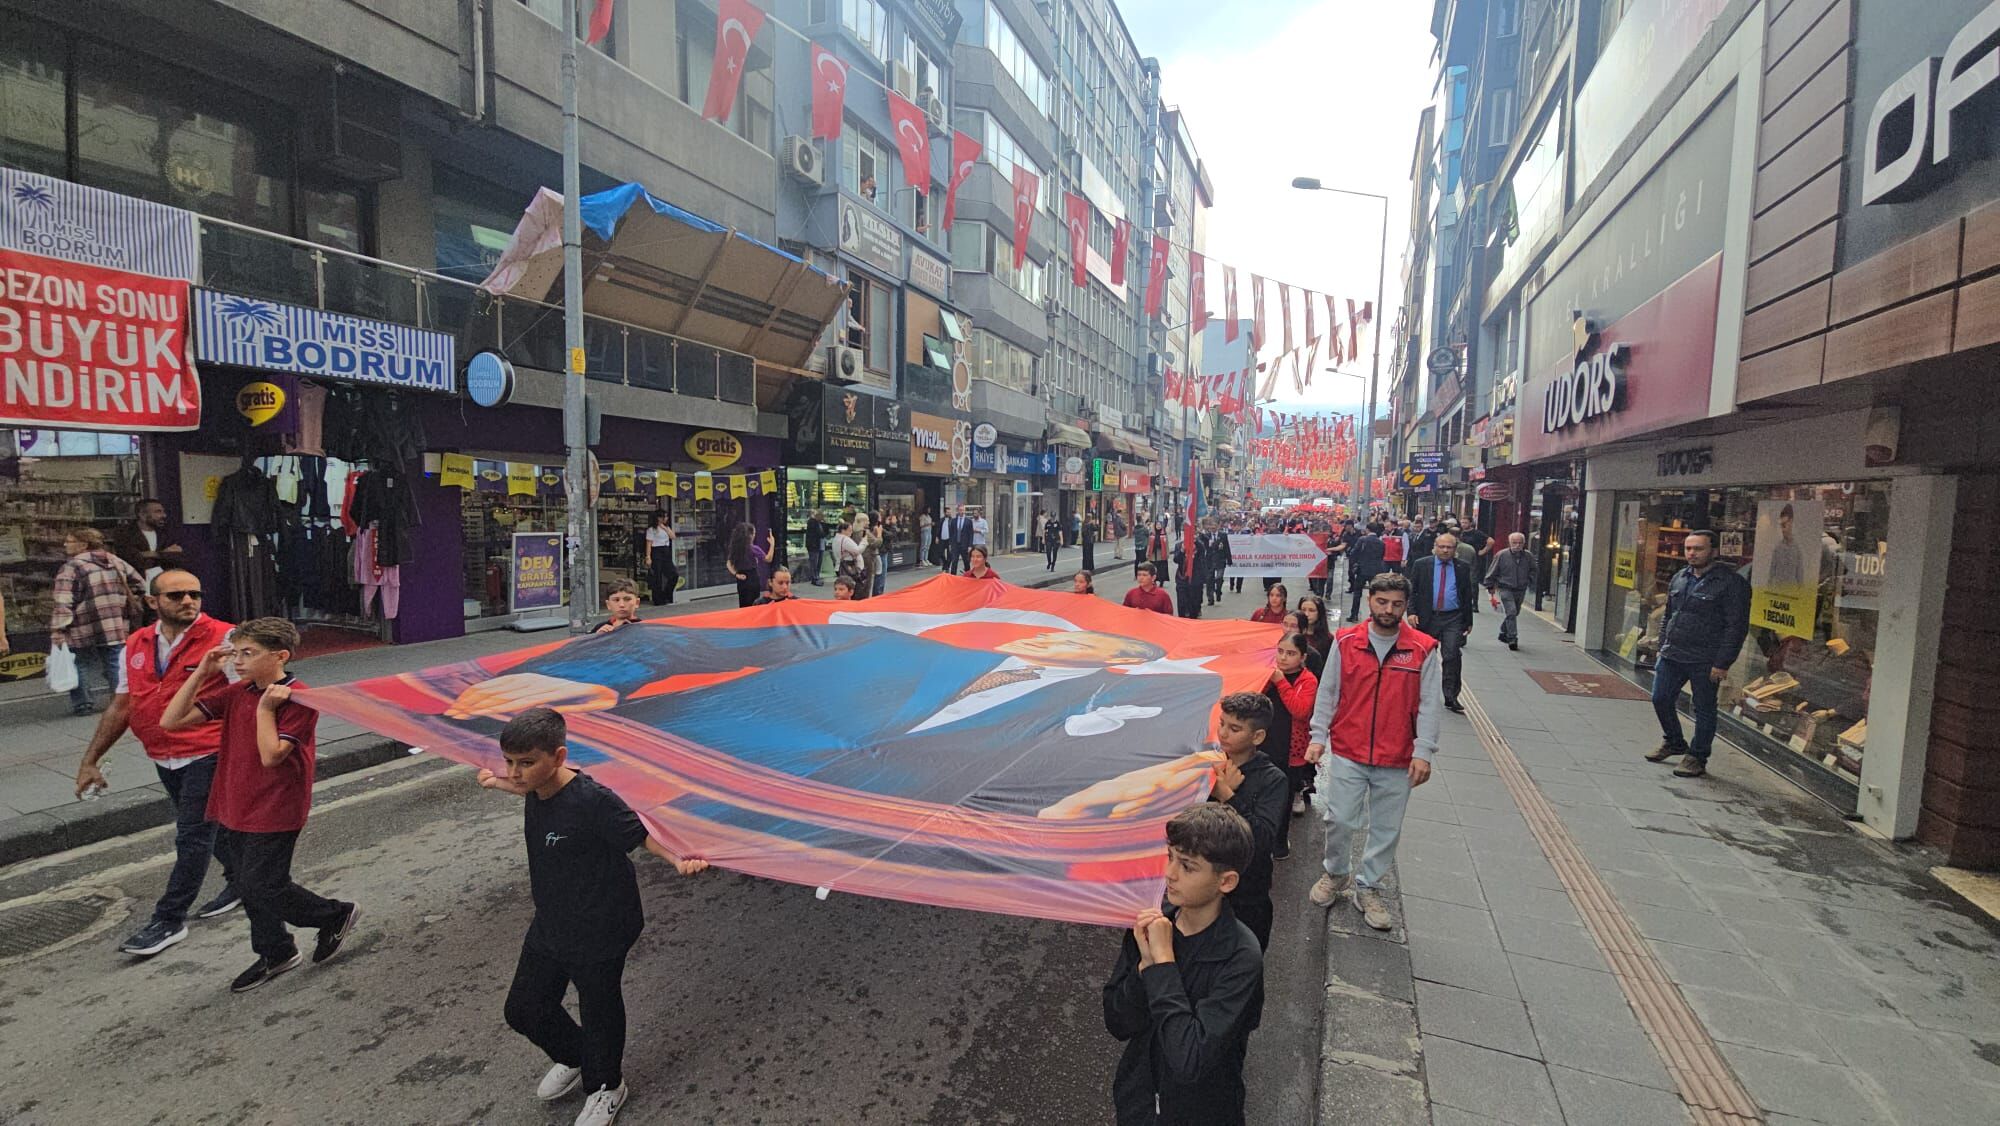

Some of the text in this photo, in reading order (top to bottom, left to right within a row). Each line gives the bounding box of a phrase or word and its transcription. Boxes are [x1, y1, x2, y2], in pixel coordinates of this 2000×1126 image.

[23, 229, 124, 262] BODRUM
[96, 284, 179, 322] SONU
[0, 305, 182, 370] BÜYÜK
[263, 334, 443, 386] BODRUM
[4, 357, 188, 415] NDİRİM
[239, 386, 276, 411] gratis
[1541, 341, 1620, 434] TUDORS
[696, 435, 737, 455] gratis
[912, 426, 950, 451] Milka
[975, 449, 995, 464] RKİYE
[521, 555, 554, 570] DEV
[1767, 610, 1796, 628] BEDAVA
